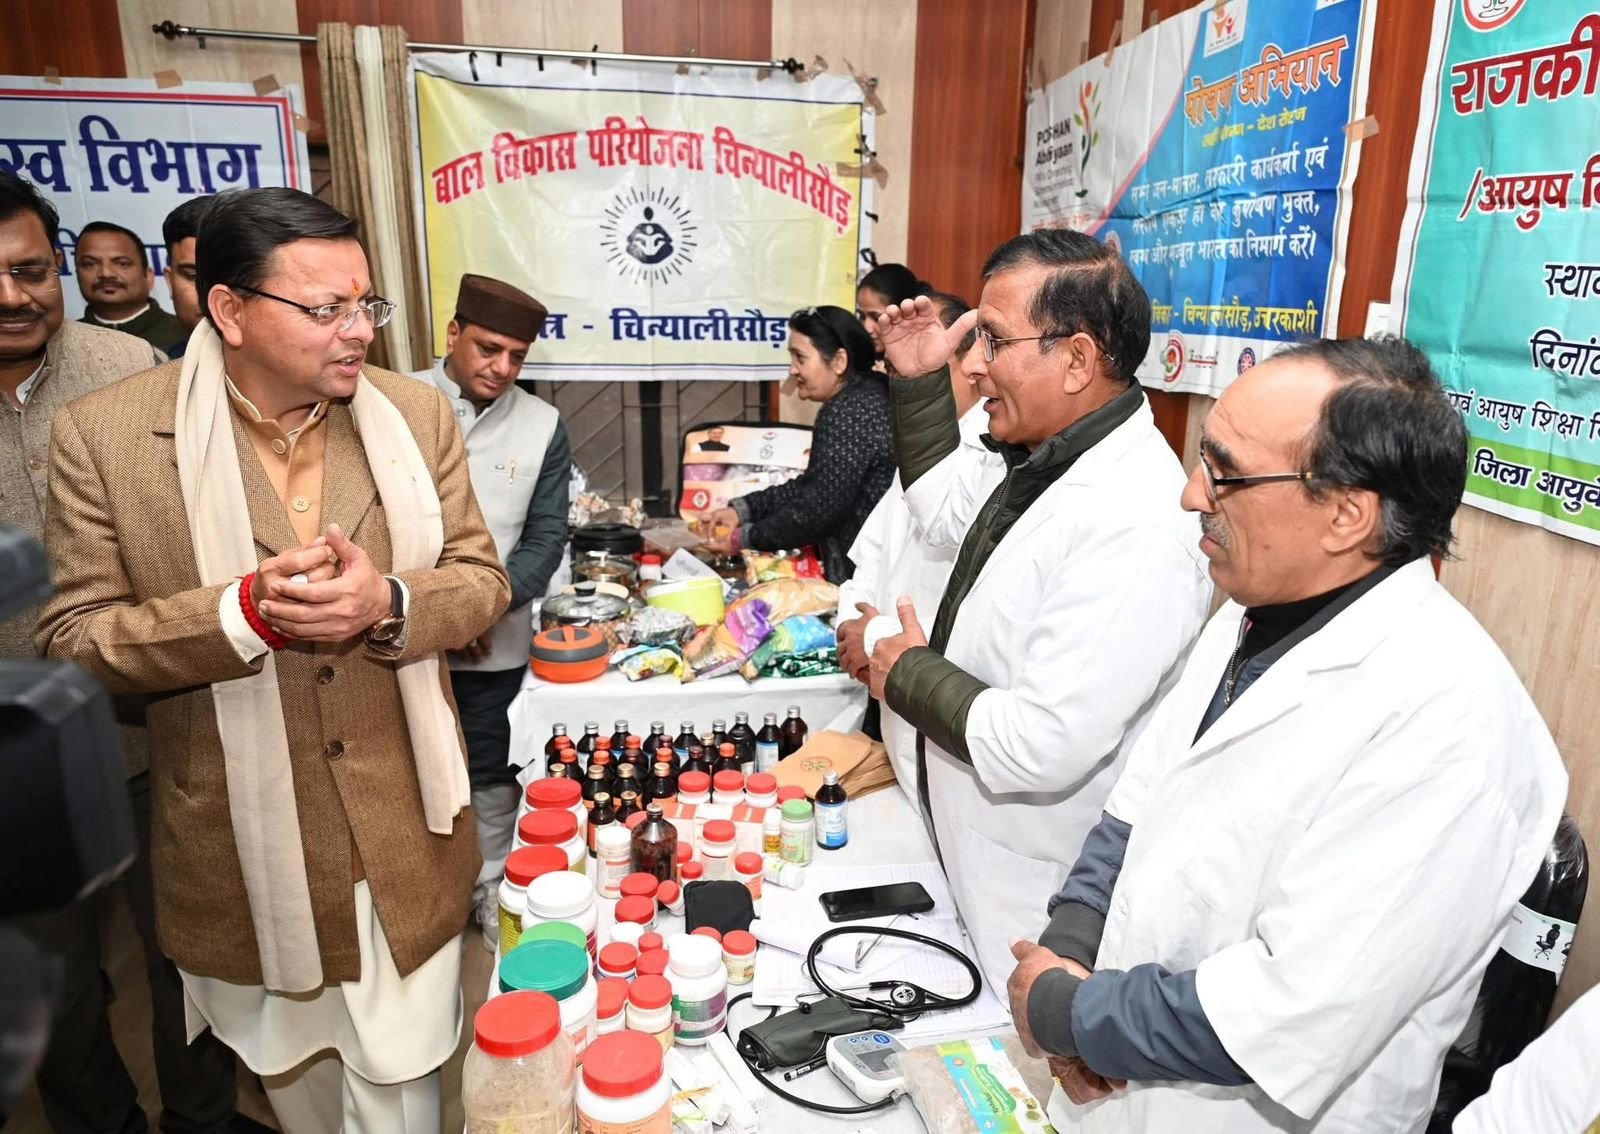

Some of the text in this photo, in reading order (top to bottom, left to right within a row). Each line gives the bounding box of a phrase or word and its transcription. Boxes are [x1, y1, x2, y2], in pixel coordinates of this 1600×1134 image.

[1185, 36, 1348, 127] पोषण अभियान
[79, 115, 262, 193] विभाग
[431, 115, 852, 234] बाल विकास परियोजना चिन्यालीसौड़
[1304, 137, 1329, 177] एवं
[609, 308, 792, 349] चिन्यालीसौड़
[1477, 397, 1527, 431] आयुष
[1531, 400, 1584, 440] शिक्षा
[1474, 448, 1532, 487] जिला
